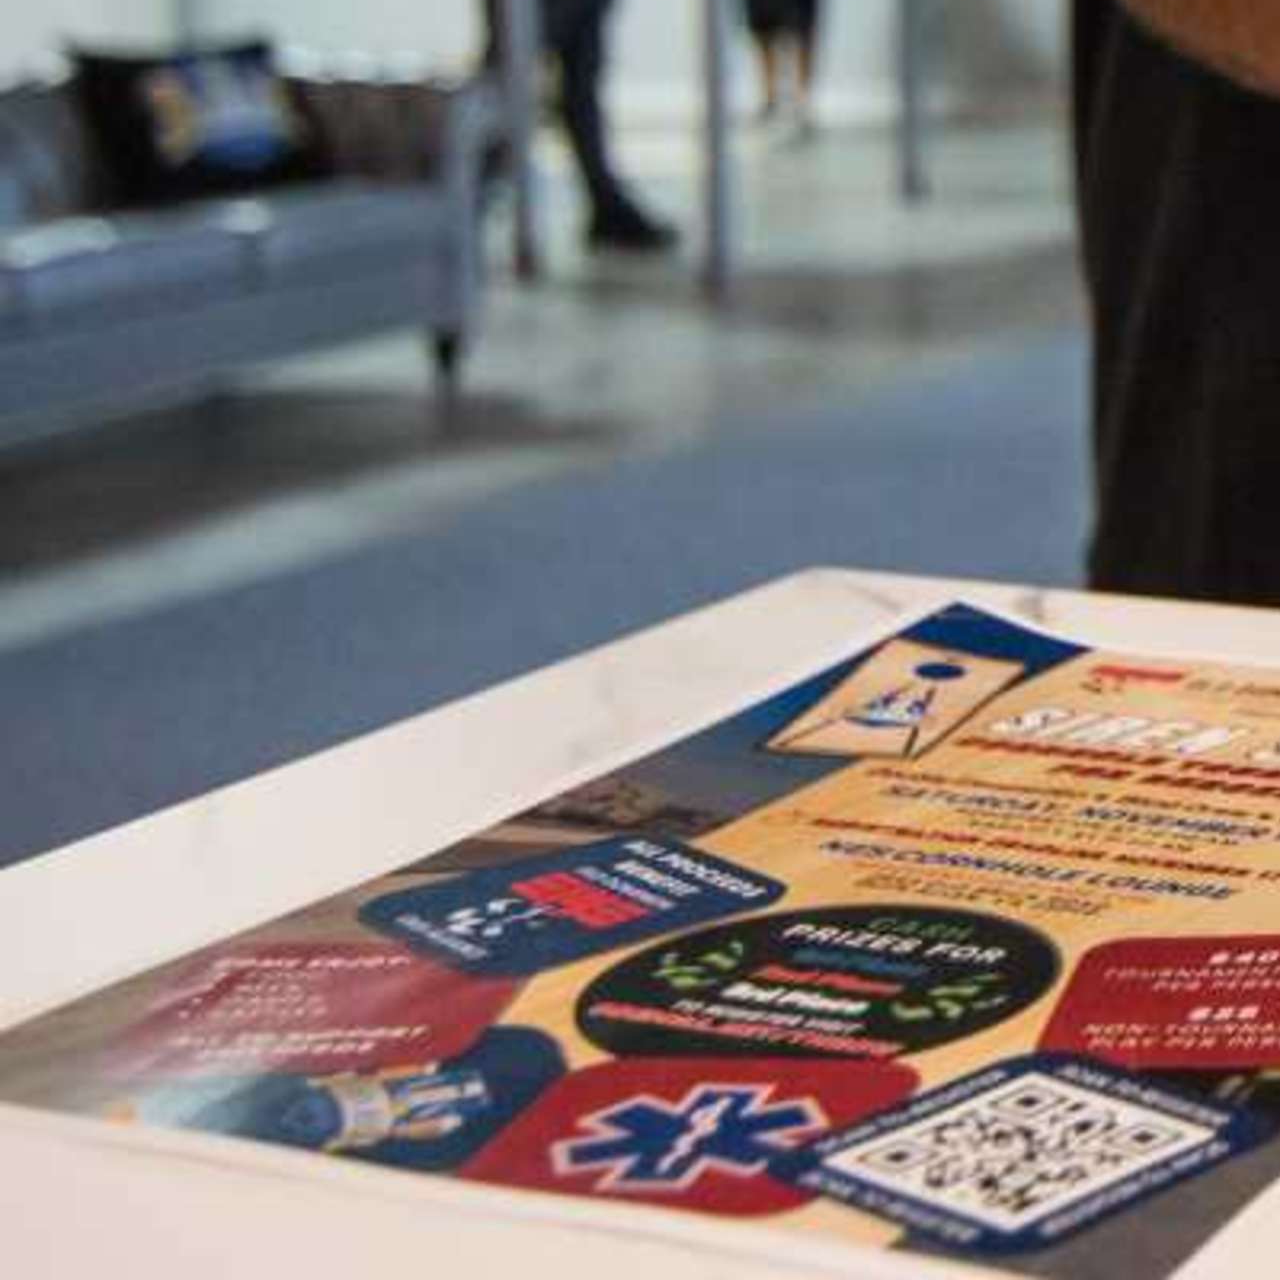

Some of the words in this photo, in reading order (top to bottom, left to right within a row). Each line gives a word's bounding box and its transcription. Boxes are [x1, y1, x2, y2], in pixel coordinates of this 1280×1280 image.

[990, 706, 1246, 757] SIREN
[1078, 805, 1272, 840] NOVEMBER
[612, 860, 700, 896] BENEFIT
[656, 852, 766, 899] PROCEEDS
[891, 848, 1086, 880] CORNHOLE
[1085, 872, 1234, 900] LOUNGE
[1112, 852, 1253, 876] NOVEMBER
[782, 923, 923, 954] PRIZES
[923, 941, 1008, 964] FOR
[868, 918, 975, 942] CASH
[1207, 949, 1280, 964] $40
[1150, 977, 1203, 992] PER
[1086, 1032, 1156, 1051] PLAY
[1162, 1032, 1218, 1050] PER
